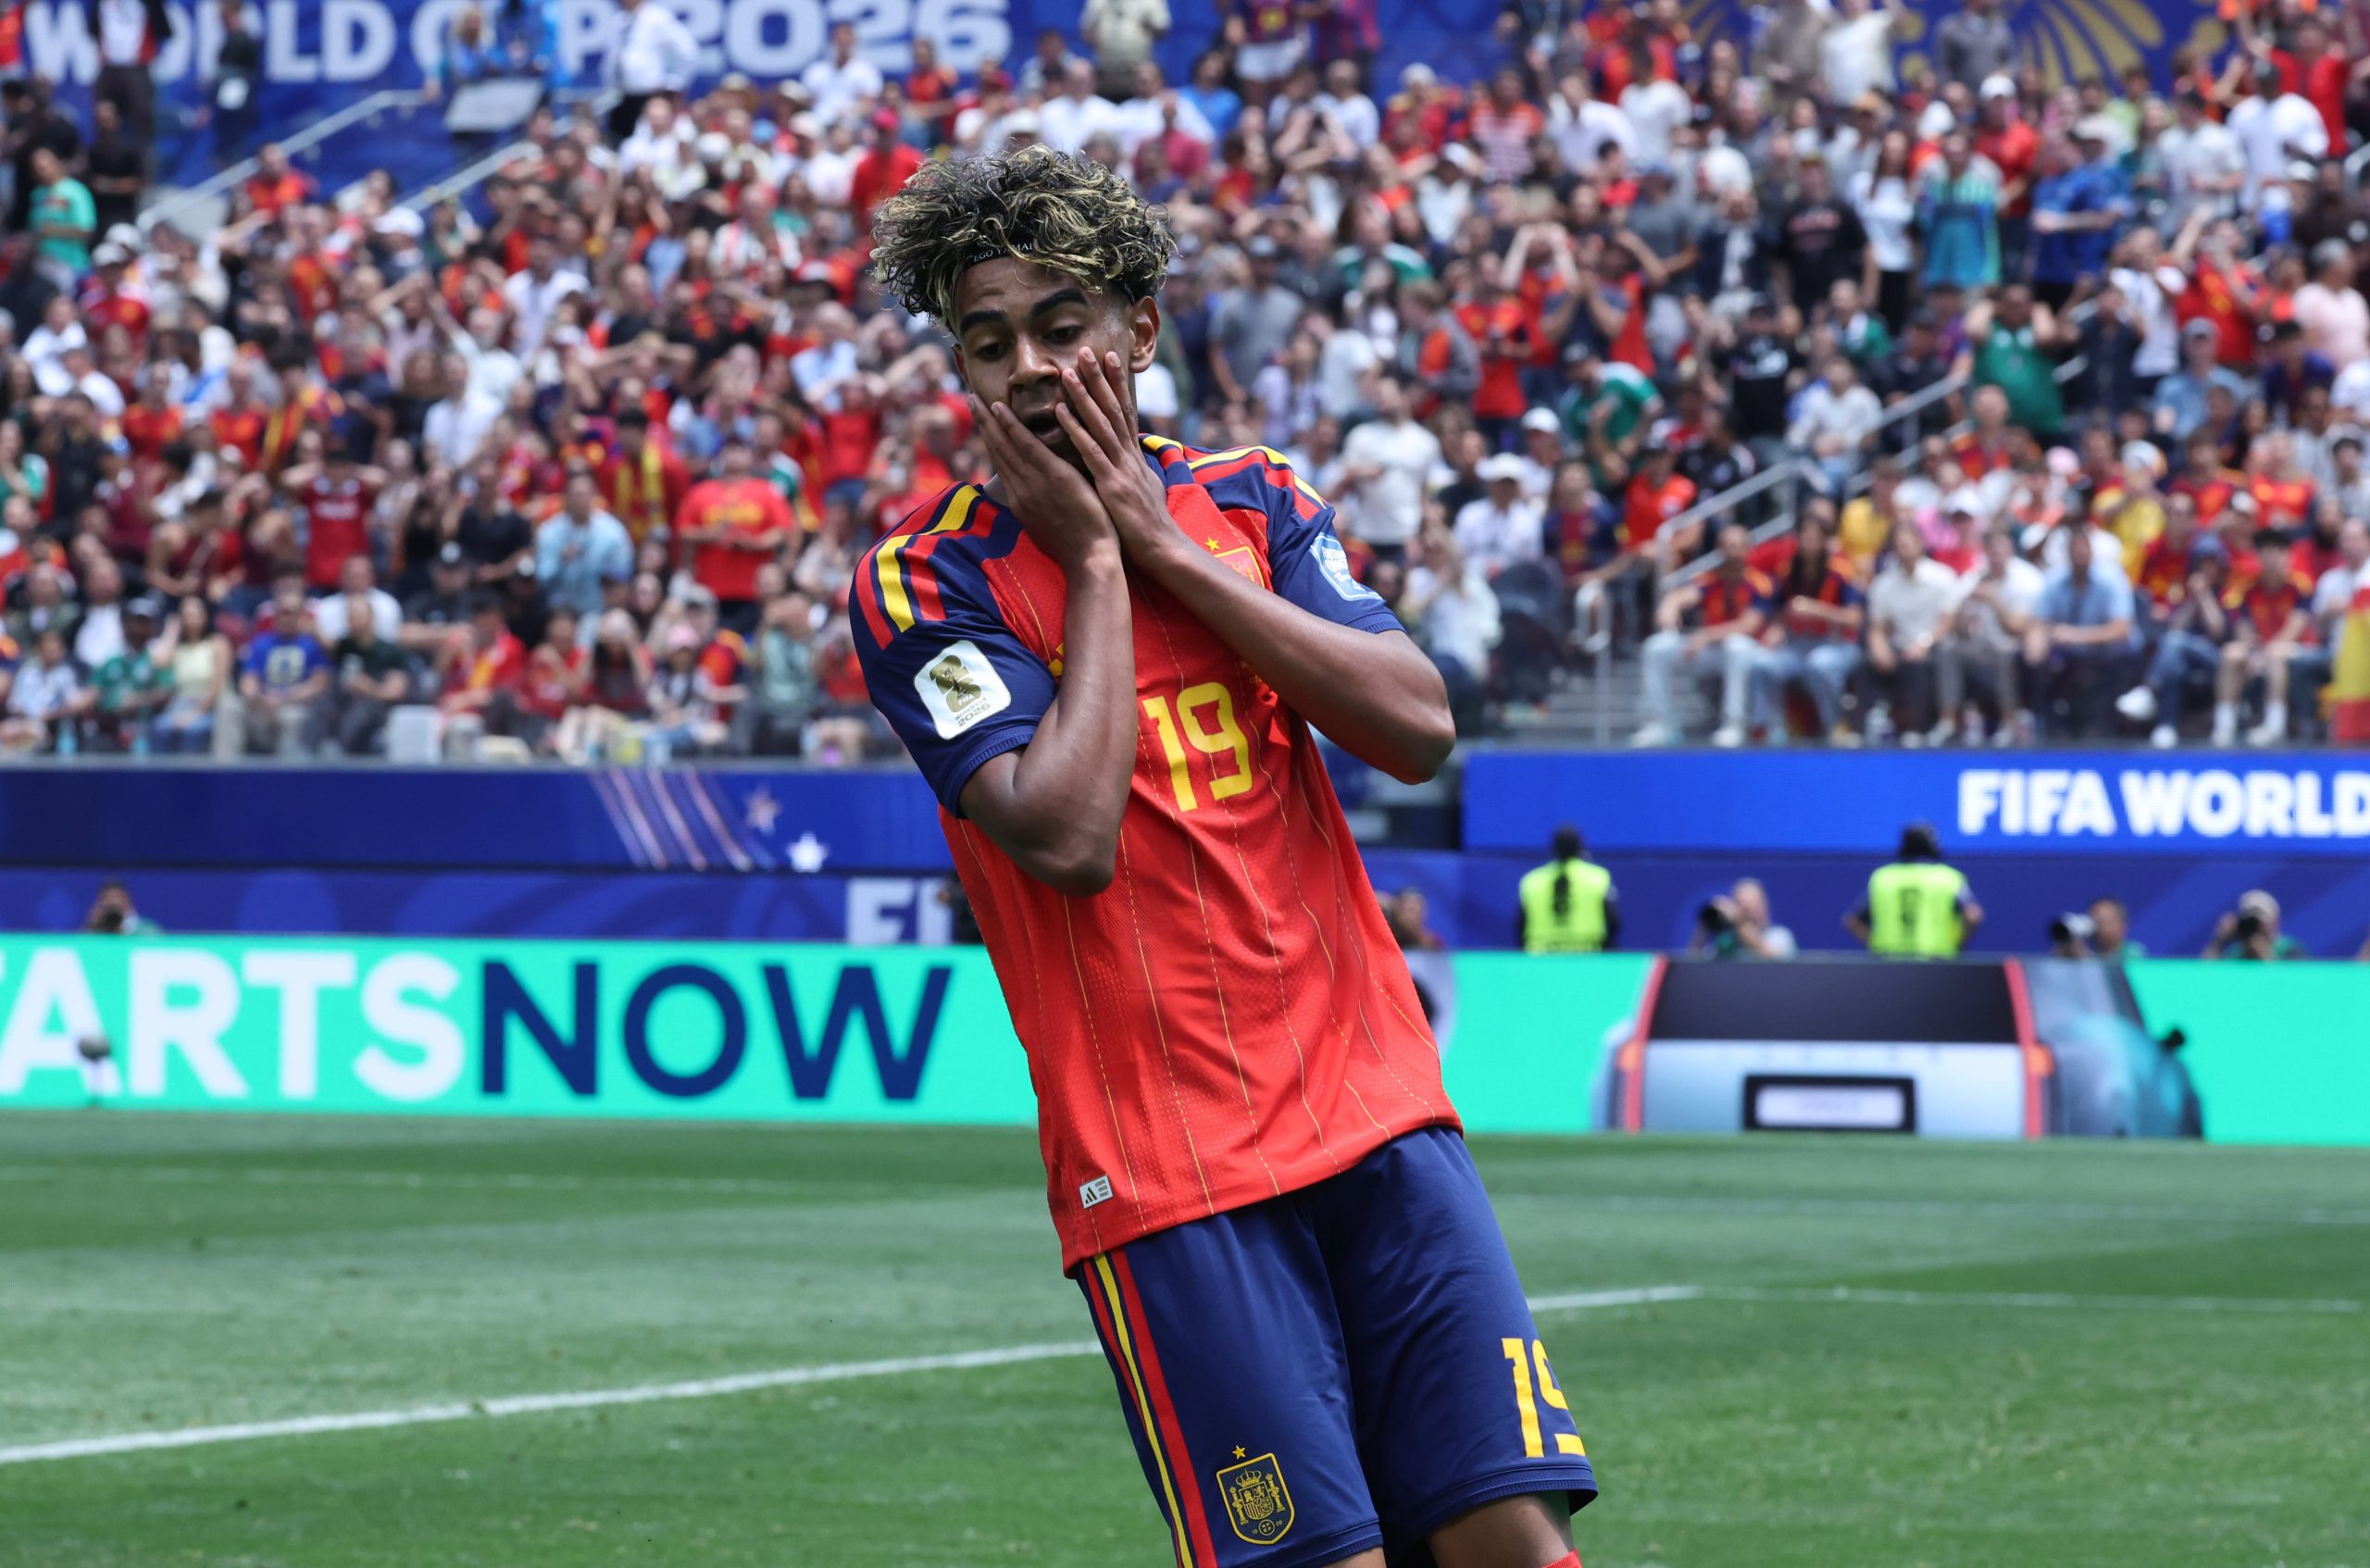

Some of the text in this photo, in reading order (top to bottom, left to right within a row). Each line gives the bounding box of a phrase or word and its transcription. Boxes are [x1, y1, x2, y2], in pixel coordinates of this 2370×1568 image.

[957, 693, 975, 706] FIFA
[957, 703, 992, 728] 2026
[1141, 681, 1253, 812] 19
[1958, 769, 2370, 837] FIFA WORLD
[846, 877, 953, 946] FI
